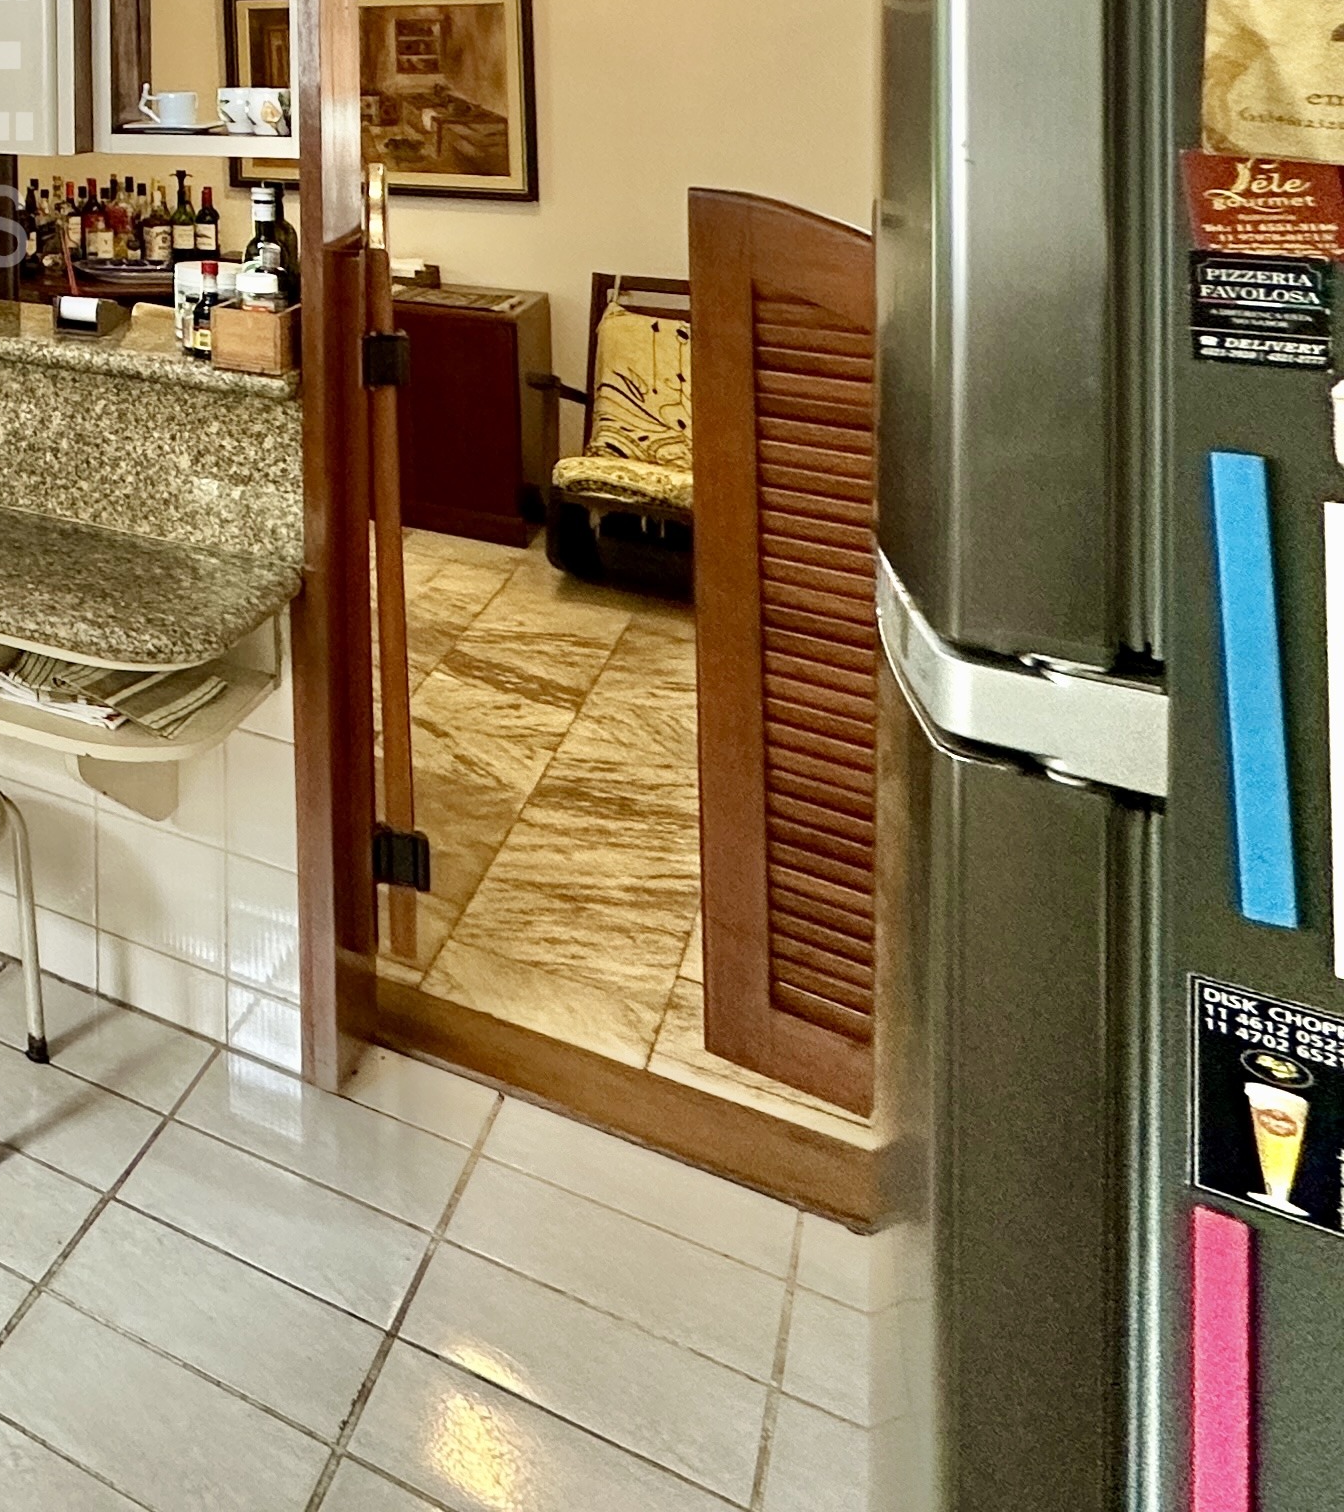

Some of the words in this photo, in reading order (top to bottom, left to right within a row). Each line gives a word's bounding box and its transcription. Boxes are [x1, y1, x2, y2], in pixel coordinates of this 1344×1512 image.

[1205, 268, 1313, 287] PIZZERIA
[1199, 284, 1320, 305] FAVOLOSA
[1223, 337, 1327, 355] DELIVERY
[1203, 987, 1259, 1015] DISK
[1204, 1003, 1228, 1020] 11
[1235, 1013, 1290, 1038] 4612
[1204, 1017, 1228, 1035] 11
[1235, 1027, 1290, 1053] 4702
